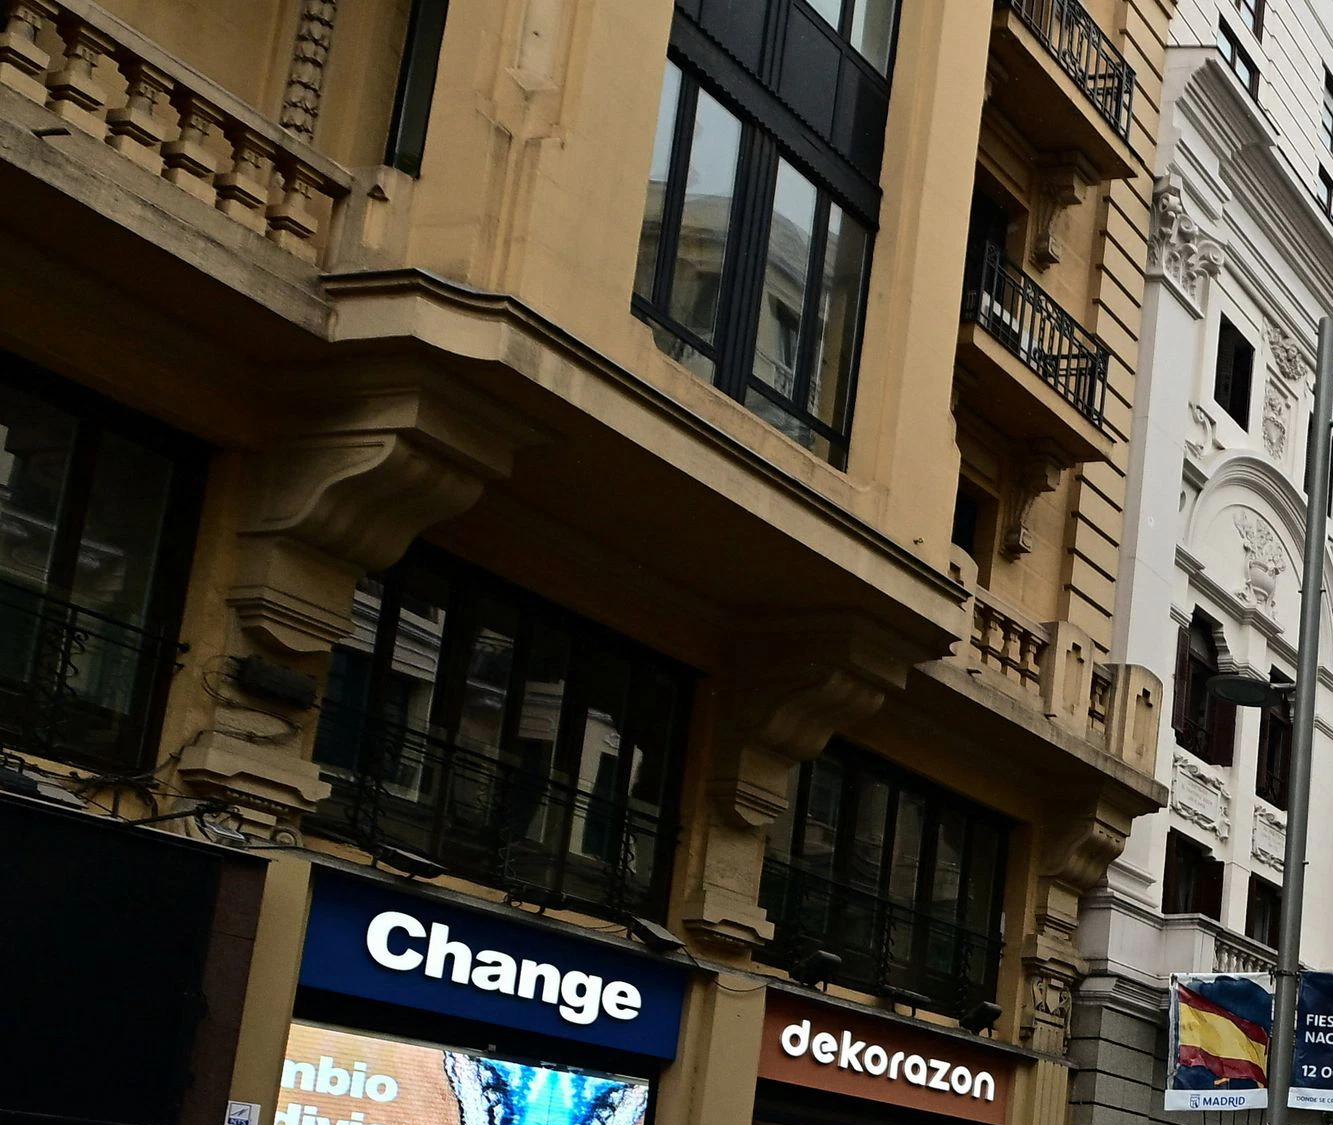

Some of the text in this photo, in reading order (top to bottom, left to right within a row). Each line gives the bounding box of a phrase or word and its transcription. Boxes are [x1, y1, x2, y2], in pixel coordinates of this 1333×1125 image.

[366, 911, 642, 1025] Change
[780, 1019, 996, 1102] dekorazon
[1302, 1064, 1317, 1078] 12
[1202, 1096, 1246, 1108] MADRID
